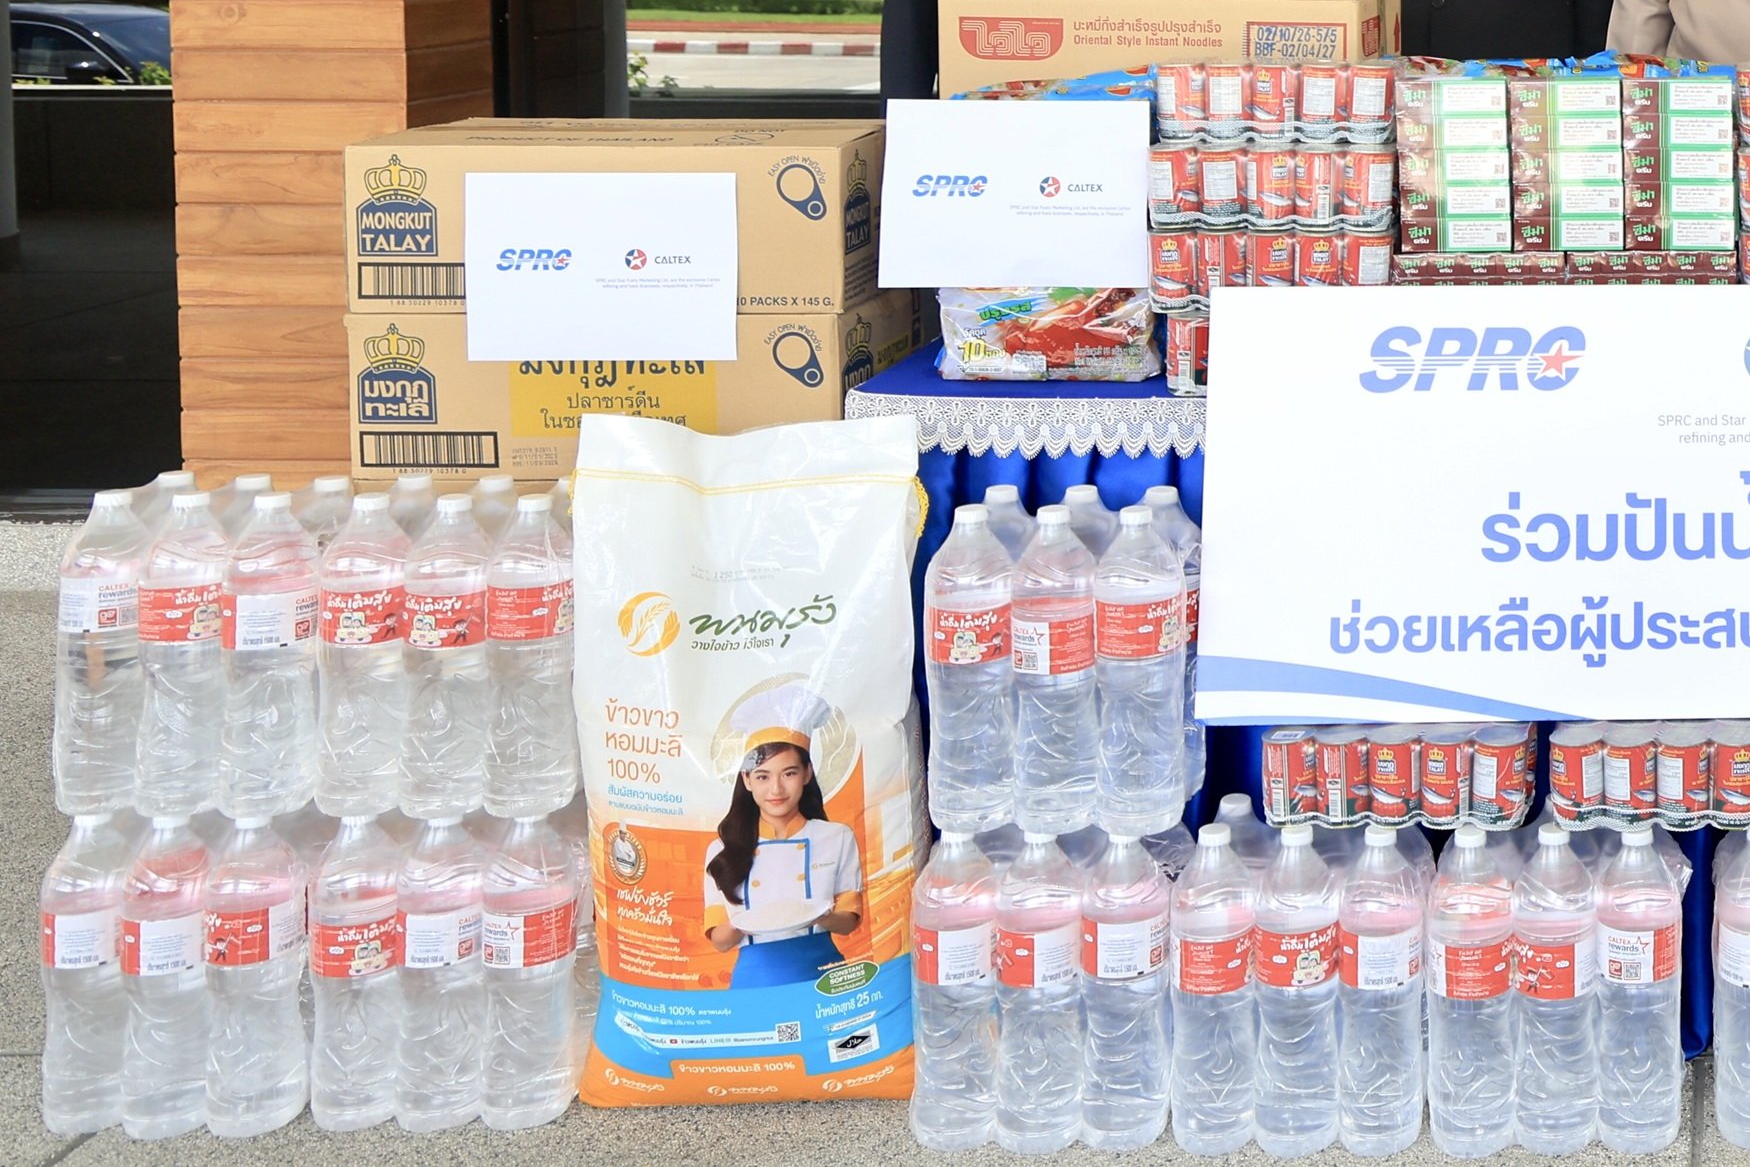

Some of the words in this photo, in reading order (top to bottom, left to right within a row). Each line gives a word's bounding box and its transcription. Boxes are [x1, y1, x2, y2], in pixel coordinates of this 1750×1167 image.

[1073, 16, 1222, 37] บะหมี่กึ่งสำเร็จรูปปรุงสำเร็จ
[1073, 34, 1112, 46] Oriental
[1116, 35, 1141, 47] Style
[1145, 35, 1179, 47] Instant
[1183, 36, 1222, 48] Noodles
[767, 161, 781, 177] EASY
[781, 155, 800, 165] OPEN
[912, 175, 988, 197] SPRC
[1068, 184, 1103, 192] CALTEX
[361, 212, 432, 230] MONGKUT
[362, 234, 431, 251] TALAY
[496, 248, 572, 271] SPRC
[654, 255, 691, 264] CALTEX
[750, 296, 788, 307] PACKS
[791, 297, 799, 306] X
[802, 297, 820, 307] 145
[823, 297, 834, 307] G.
[764, 330, 777, 345] EASY
[777, 323, 795, 333] OPEN
[959, 339, 985, 363] 10
[1359, 326, 1586, 394] SPRC
[364, 378, 428, 403] มงกุฎ
[567, 384, 660, 409] ปลาซาร์ดีน
[364, 403, 429, 417] ทะเล
[1658, 415, 1691, 426] SPRC
[1695, 414, 1718, 426] and
[1721, 414, 1746, 426] Star
[1679, 430, 1726, 445] refining
[1729, 431, 1750, 443] and
[689, 594, 837, 648] พนมรุ้ง
[691, 638, 740, 652] วางใจข้าว
[743, 637, 774, 651] ไว้ใจเรา
[605, 698, 680, 729] ข้าวขาว
[605, 731, 683, 757] หอมมะลิ
[607, 758, 661, 784] 100%
[608, 784, 683, 803] สัมผัสความอร่อย
[1608, 935, 1631, 944] CALTEX
[1608, 943, 1639, 953] rewards
[829, 964, 865, 979] CONSTANT
[829, 970, 865, 985] SOFTNESS
[668, 1005, 695, 1016] 100%
[815, 997, 856, 1018] น้ำหนักสุทธิ
[856, 991, 870, 1007] 25
[679, 1062, 760, 1073] ข้าวขาวหอมมะลิ
[764, 1061, 795, 1072] 100%
